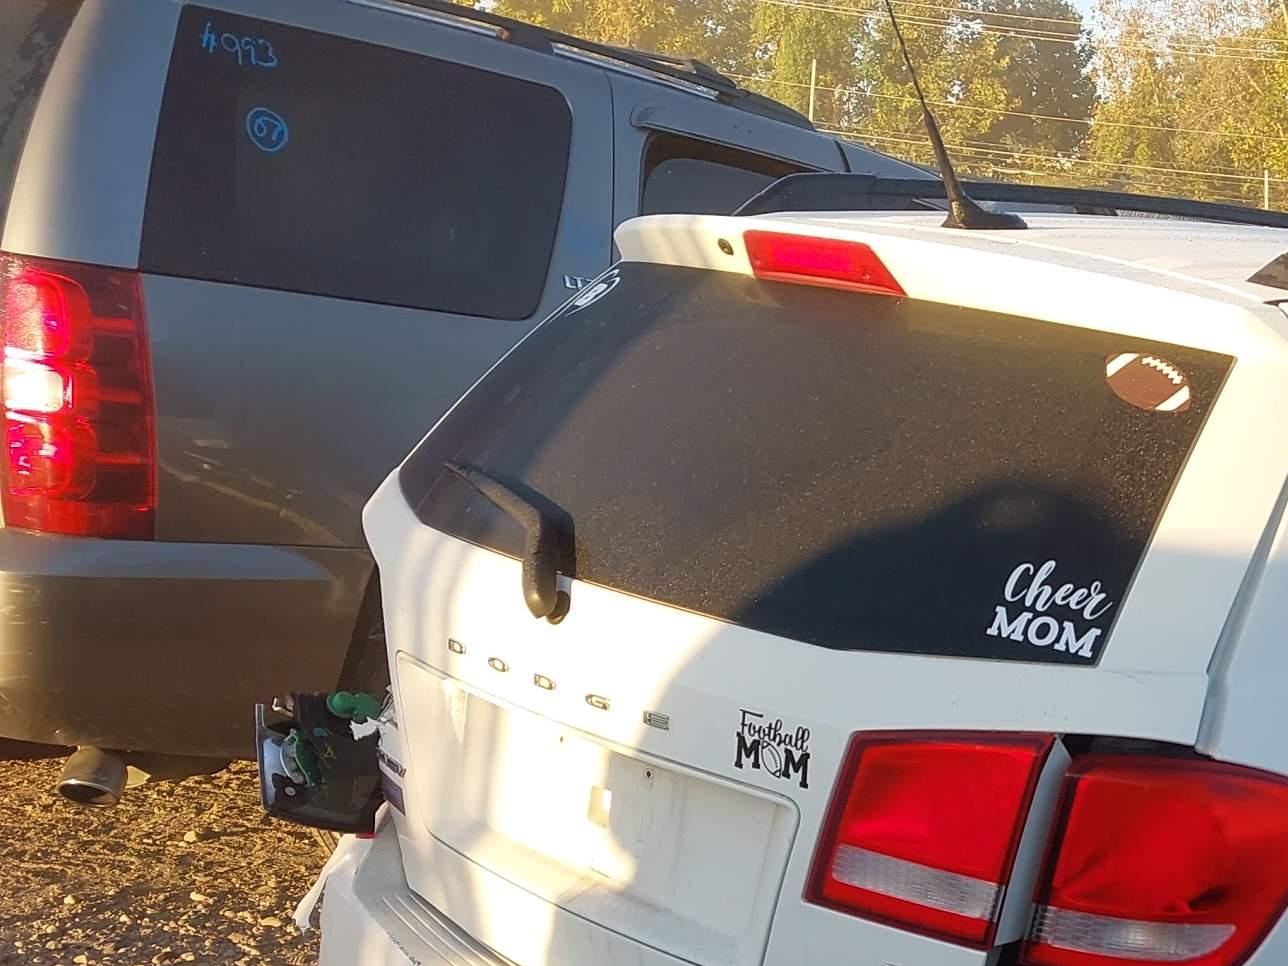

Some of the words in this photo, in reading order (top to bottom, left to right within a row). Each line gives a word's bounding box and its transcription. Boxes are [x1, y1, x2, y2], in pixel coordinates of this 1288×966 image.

[1004, 560, 1113, 620] Cheer
[986, 605, 1102, 658] MOM
[447, 638, 670, 731] DODGE
[739, 708, 810, 752] Football
